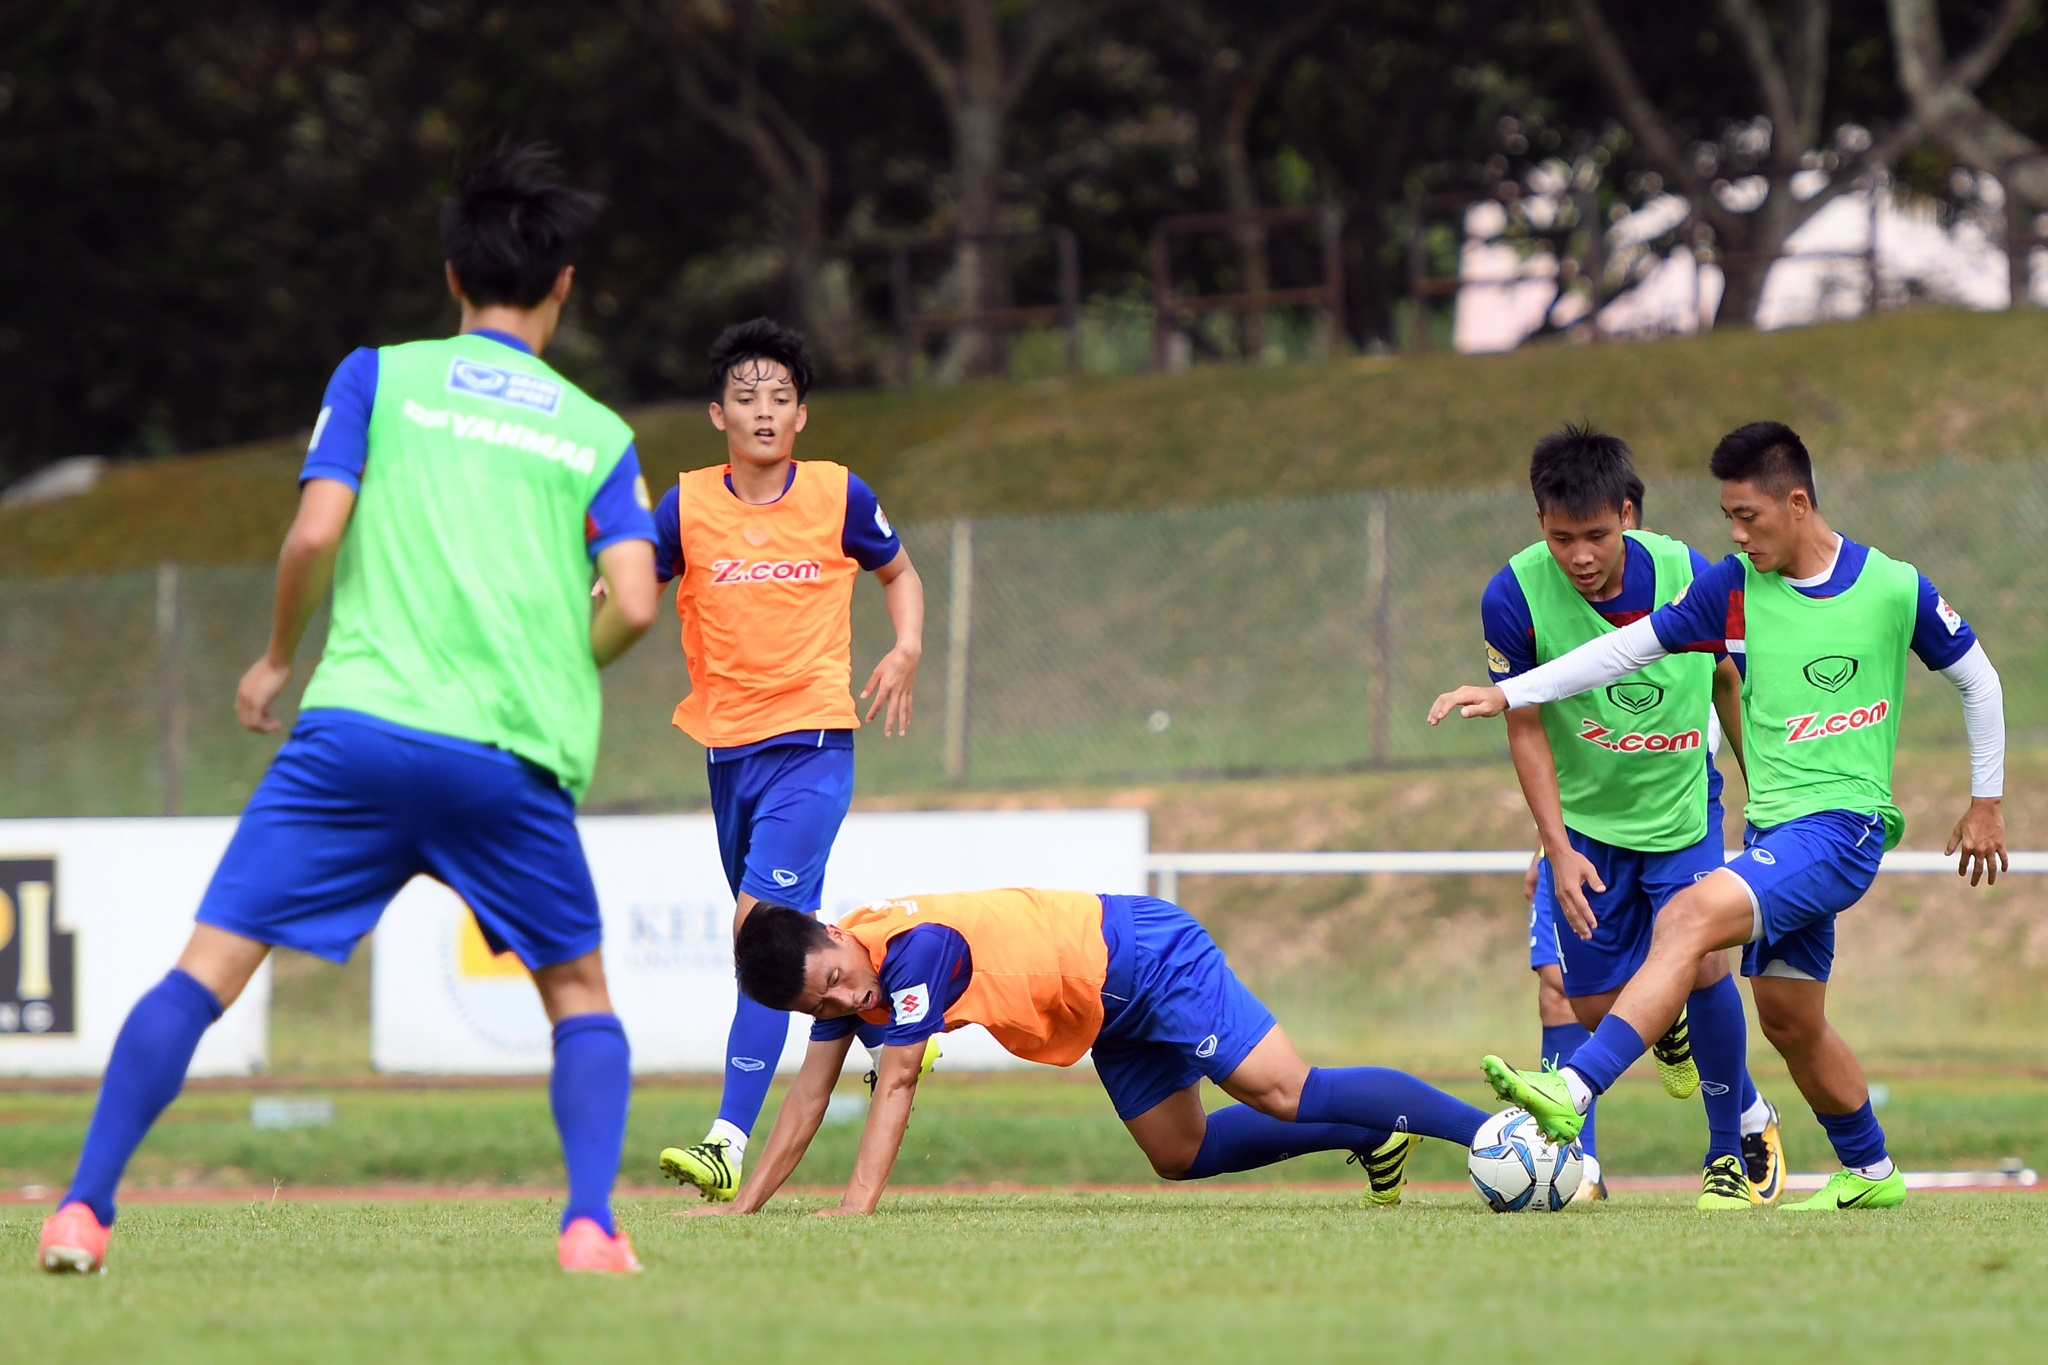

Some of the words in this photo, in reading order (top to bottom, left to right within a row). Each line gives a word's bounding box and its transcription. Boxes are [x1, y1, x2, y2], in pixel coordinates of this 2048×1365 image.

[451, 411, 597, 475] YANMAR
[711, 558, 822, 586] Z.com
[1576, 718, 1702, 753] Z.com
[1785, 699, 1889, 744] Z.com
